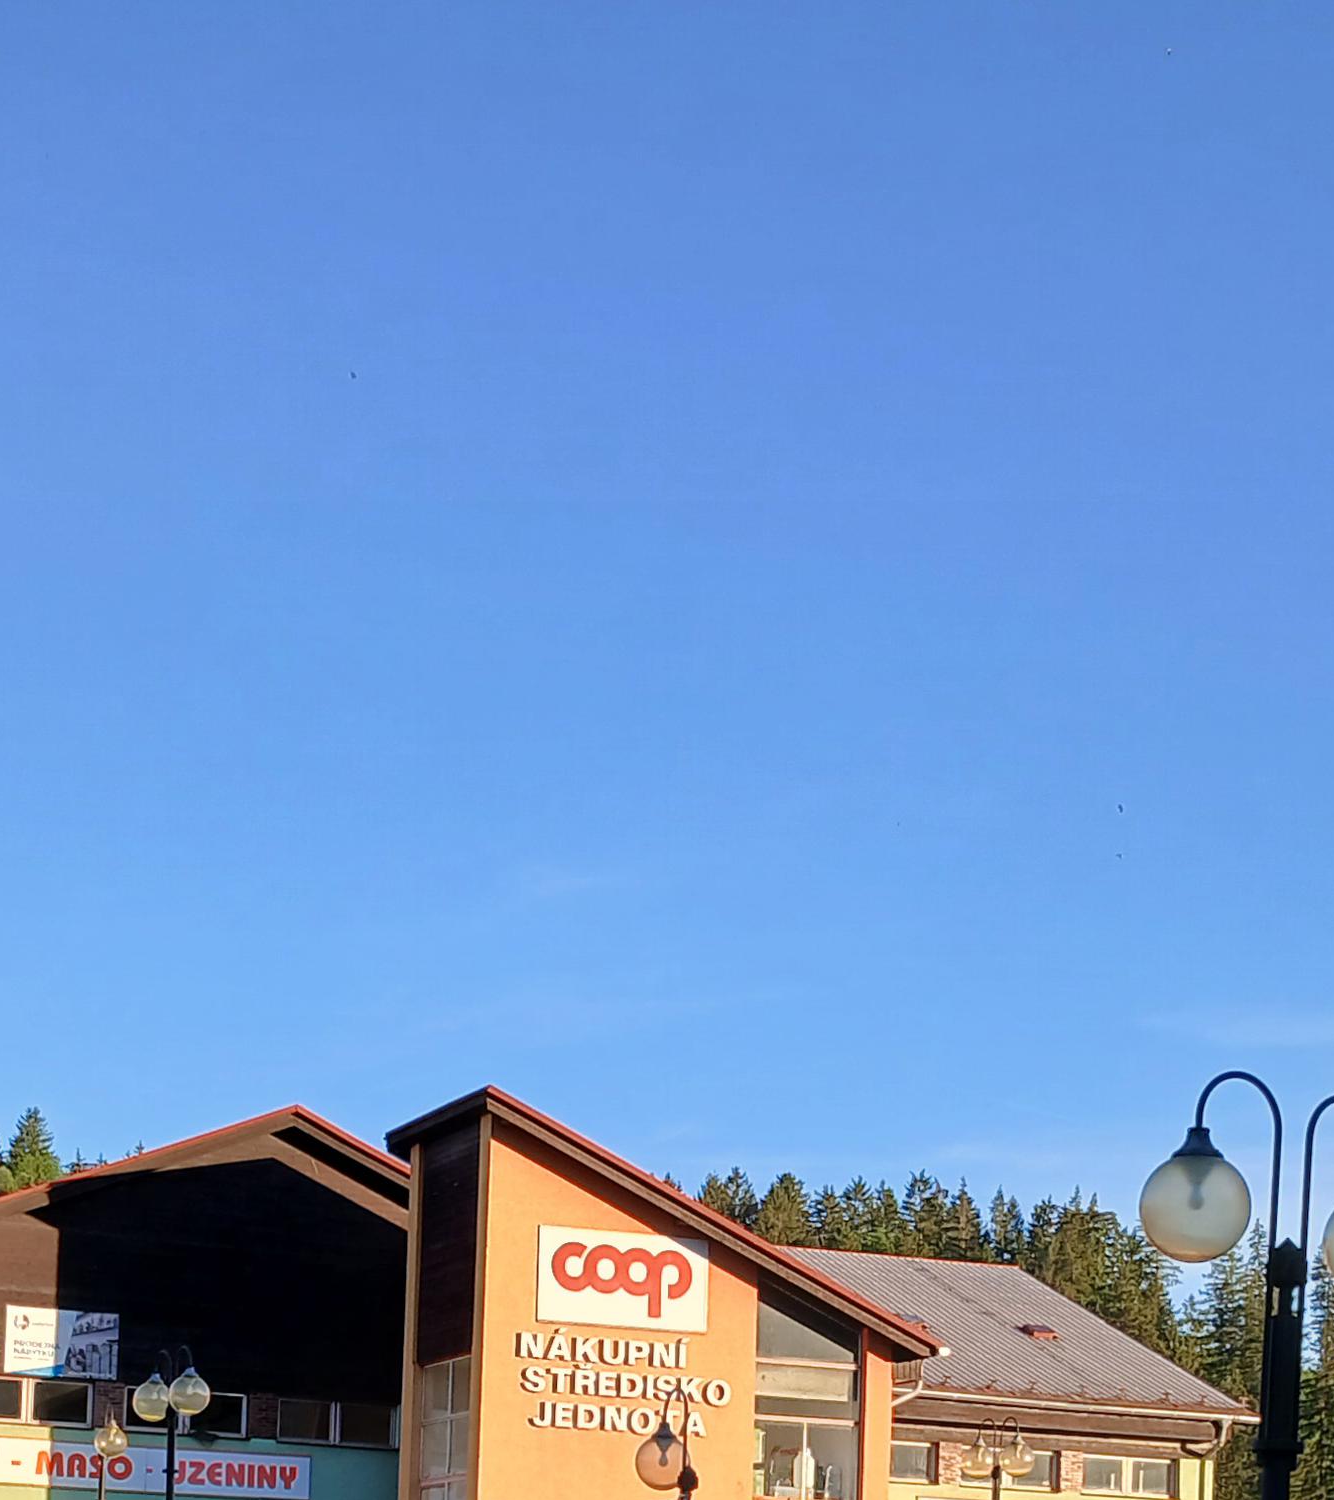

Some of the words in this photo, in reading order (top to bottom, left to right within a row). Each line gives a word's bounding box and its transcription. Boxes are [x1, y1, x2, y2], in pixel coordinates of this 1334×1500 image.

[551, 1241, 693, 1319] coop
[517, 1327, 691, 1369] NÁKUPNÍ
[522, 1362, 732, 1407] STŘEDISKO
[530, 1400, 708, 1438] JEDNOTA
[35, 1450, 133, 1481] MASO
